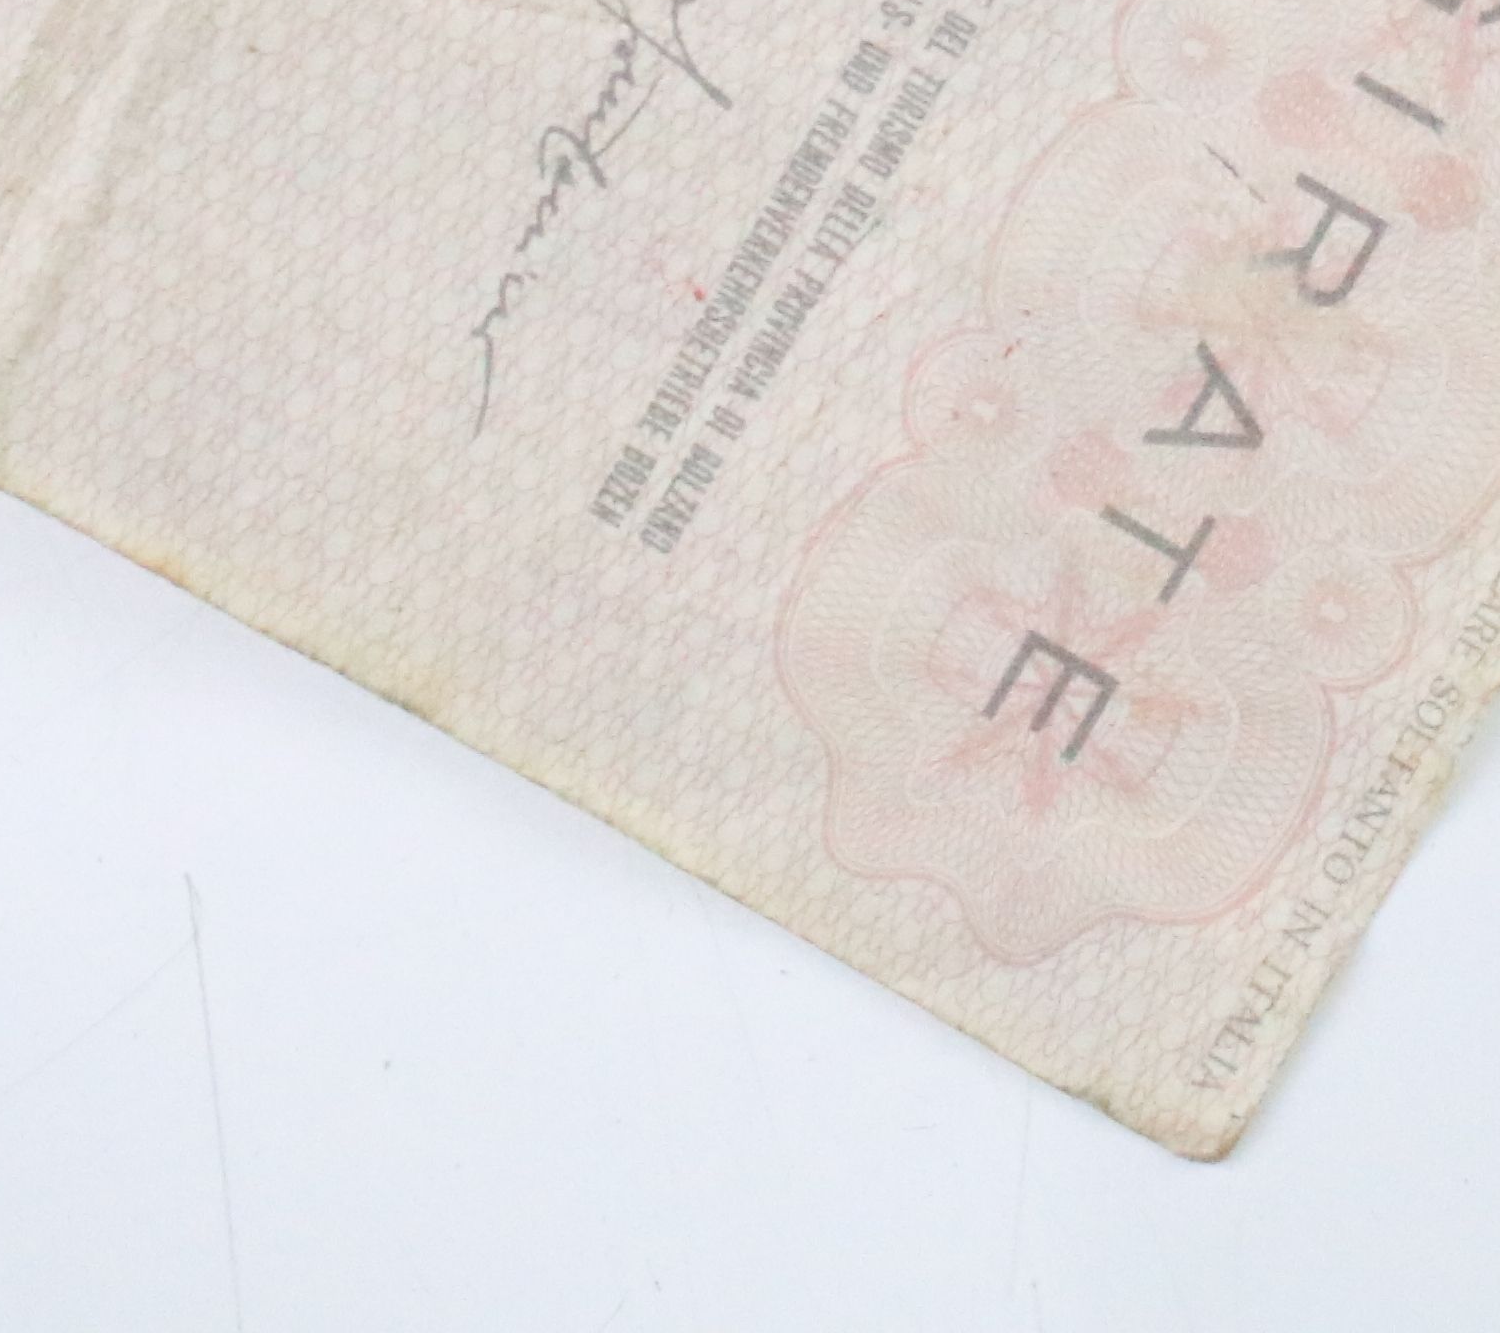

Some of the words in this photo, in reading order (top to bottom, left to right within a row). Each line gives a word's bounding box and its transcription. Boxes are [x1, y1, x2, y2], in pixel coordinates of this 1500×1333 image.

[837, 36, 896, 99] UND
[923, 7, 981, 68] DEL
[855, 61, 947, 182] TURISMO
[806, 178, 880, 267] DELLA
[725, 265, 829, 407] PROVINCIA
[704, 402, 751, 444] DI
[586, 443, 659, 531] BOZEN
[636, 440, 726, 558] BOLZANO
